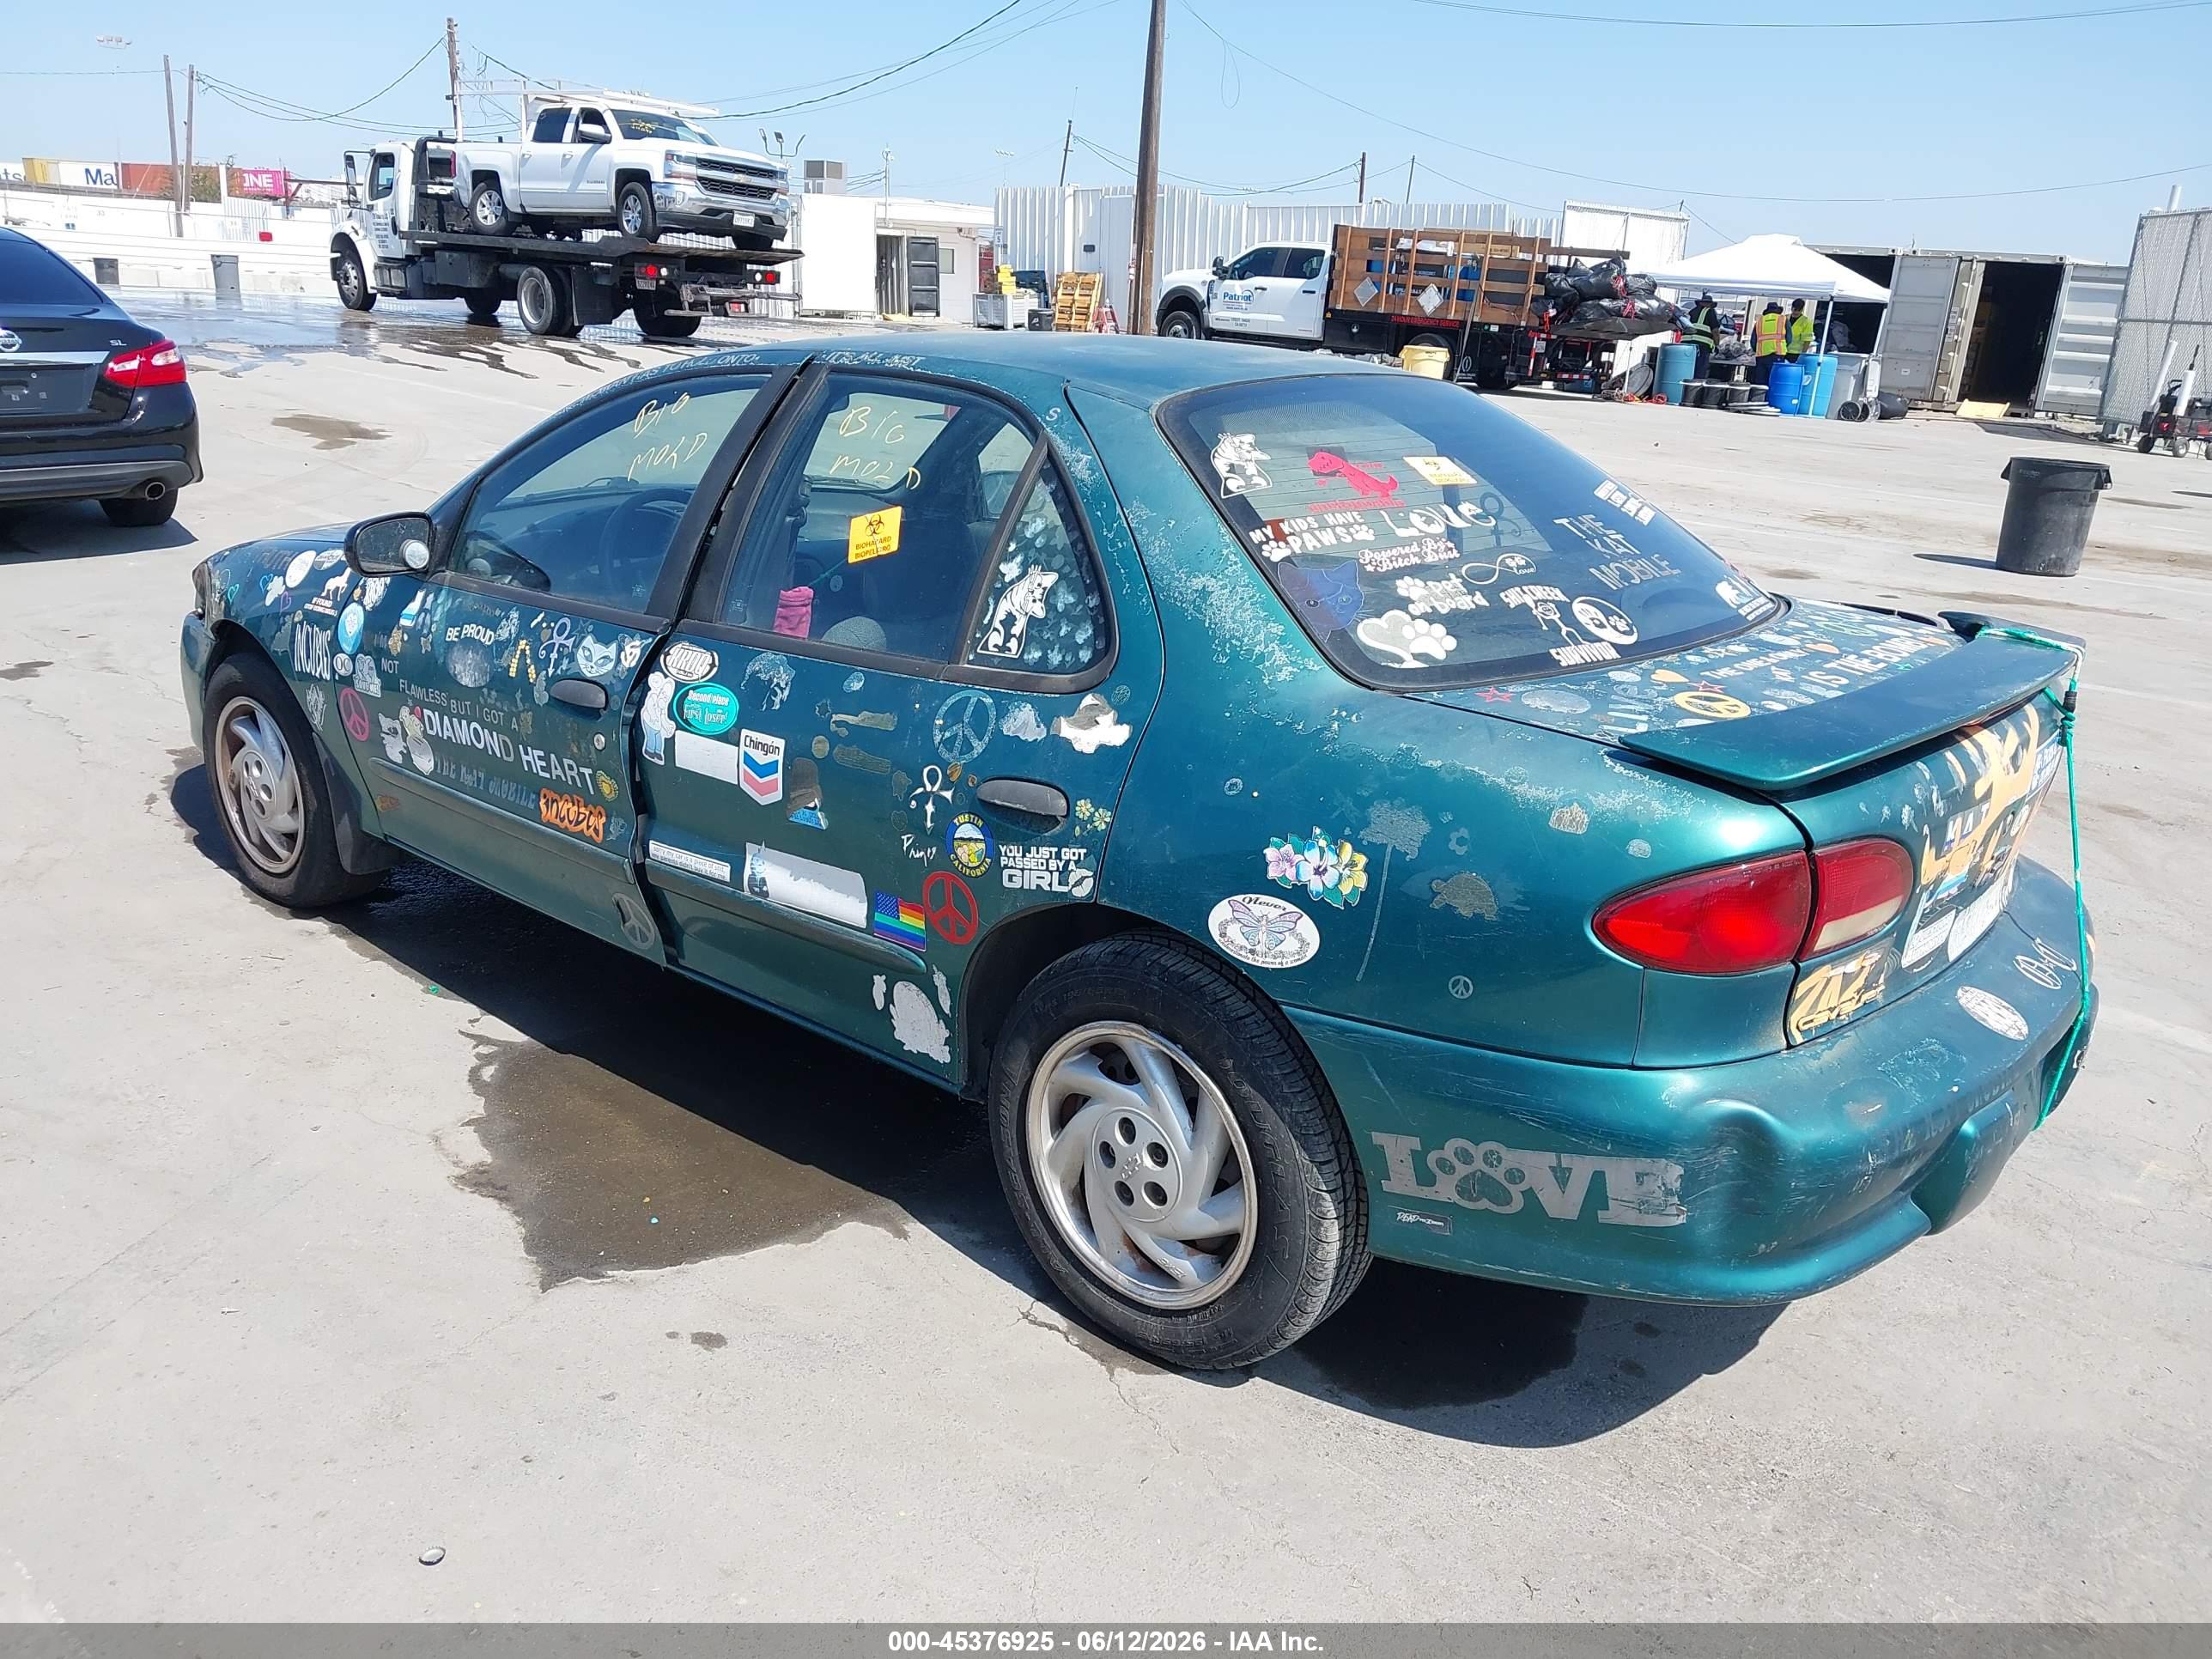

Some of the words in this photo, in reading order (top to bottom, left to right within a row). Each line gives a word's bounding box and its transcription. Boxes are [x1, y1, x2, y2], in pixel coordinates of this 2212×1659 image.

[1223, 292, 1251, 301] Patriot
[1249, 525, 1275, 544] MY
[1279, 516, 1319, 535] KIDS
[1322, 511, 1365, 526] HAVE
[1286, 526, 1353, 554] PAWS
[1358, 542, 1420, 564] Powered
[1374, 554, 1420, 572] Bitch
[1589, 554, 1682, 590] MOBILE
[446, 628, 460, 641] BE
[460, 623, 495, 646] PROUD
[294, 621, 331, 681] INCUBUS
[1549, 641, 1621, 666] SURVIVOR
[381, 658, 399, 674] NOT
[1701, 665, 1744, 679] THE
[1822, 654, 1890, 676] THE
[1801, 671, 1849, 688] IS
[398, 679, 447, 707] FLAWLESS
[450, 699, 471, 716] BUT
[483, 708, 505, 726] GOT
[511, 717, 519, 731] A
[422, 708, 514, 763] DIAMOND
[518, 744, 595, 795] HEART
[744, 734, 781, 757] Chingón
[953, 812, 984, 828] TUSTIN
[999, 844, 1024, 858] YOU
[1025, 846, 1058, 859] JUST
[1060, 847, 1087, 860] GOT
[950, 854, 992, 878] CALIFORNIA
[1000, 856, 1047, 870] PASSED
[1048, 859, 1065, 871] BY
[1067, 860, 1077, 872] A
[1002, 869, 1071, 892] GIRL
[1242, 896, 1287, 911] Never
